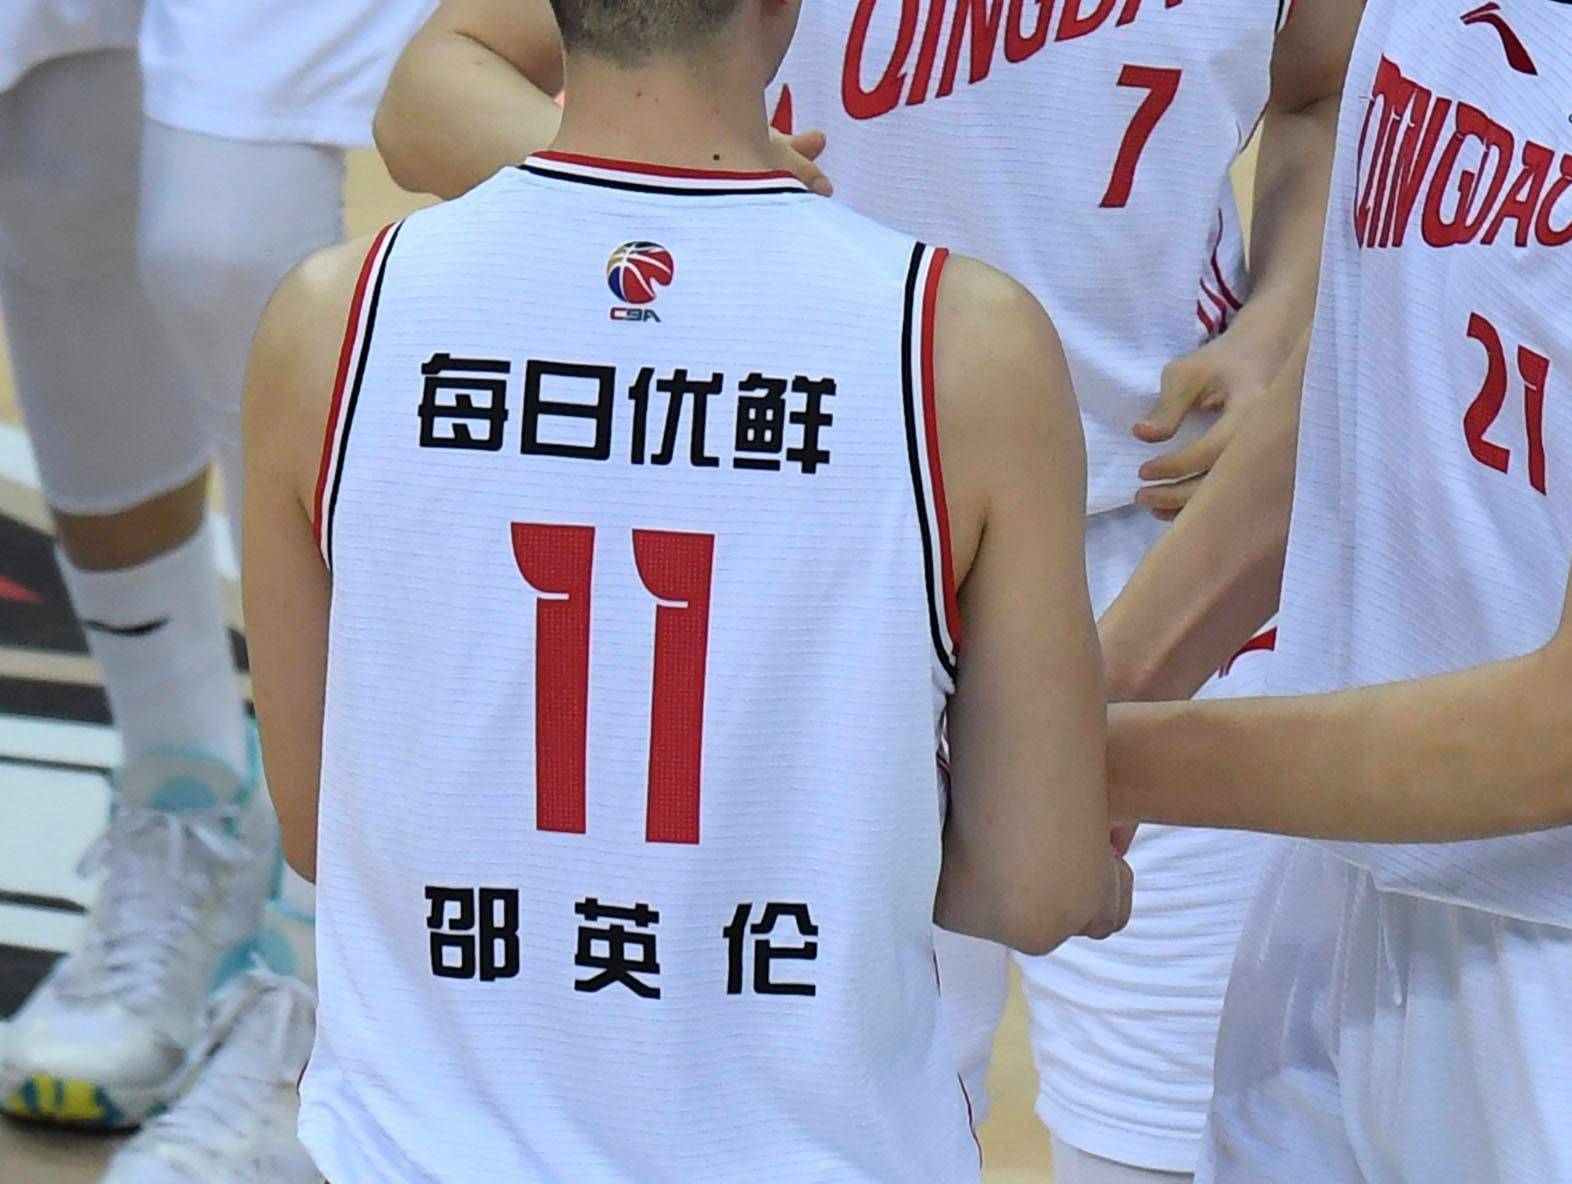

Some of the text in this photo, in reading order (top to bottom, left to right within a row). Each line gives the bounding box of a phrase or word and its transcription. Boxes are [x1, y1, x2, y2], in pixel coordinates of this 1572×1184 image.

[1098, 63, 1183, 208] 7
[610, 307, 662, 323] CBA
[417, 352, 837, 475] 每日优鲜
[1463, 311, 1550, 497] 21
[510, 521, 716, 846] 11
[424, 884, 819, 1000] 邵英伦
